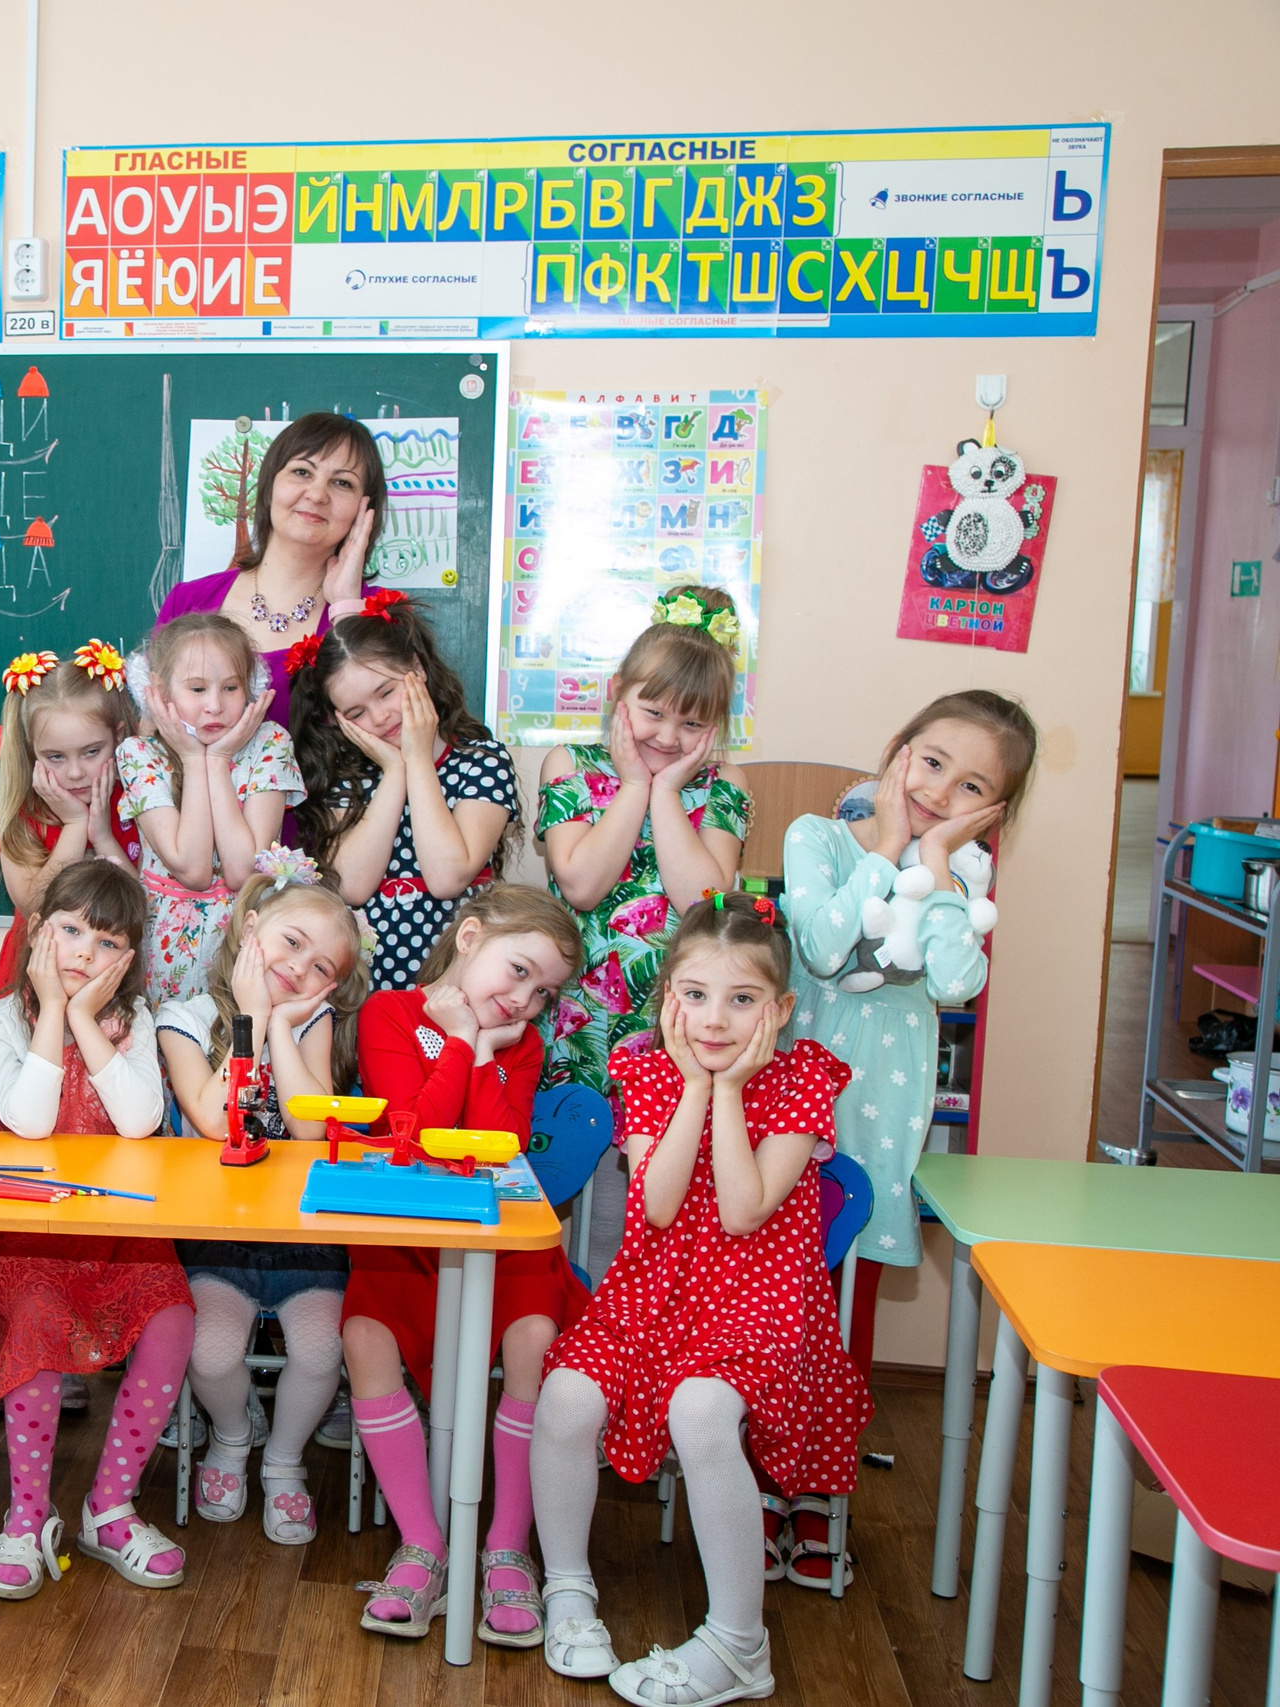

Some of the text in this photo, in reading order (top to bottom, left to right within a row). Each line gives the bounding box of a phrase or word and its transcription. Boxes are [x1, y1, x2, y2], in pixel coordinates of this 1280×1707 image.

[1061, 136, 1104, 144] ОБОЗНАЧАЮТ
[113, 150, 248, 172] ГЛАСНЫЕ
[567, 140, 757, 164] СОГЛАСНЫЕ
[298, 174, 826, 234] Й Н М Л Р Б В Г Д Ж З
[893, 192, 1024, 203] ЗВОНКИЕ СОГЛАСНЫЕ
[1053, 169, 1093, 221] Ь
[67, 184, 288, 236] А О У Ы Э
[69, 249, 282, 307] Я Ё Ю И Е
[368, 273, 478, 285] ГЛУХИЕ СОГЛАСНЫЕ
[536, 248, 1036, 309] П Ф К Т Ш С Х Ц Ч Щ
[1047, 248, 1091, 299] Ъ
[9, 317, 37, 331] 220
[668, 317, 738, 326] СОГЛАСНЫЕ
[928, 596, 1005, 616] КАРТОН
[924, 612, 1005, 633] ЦВЕТНОЙ
